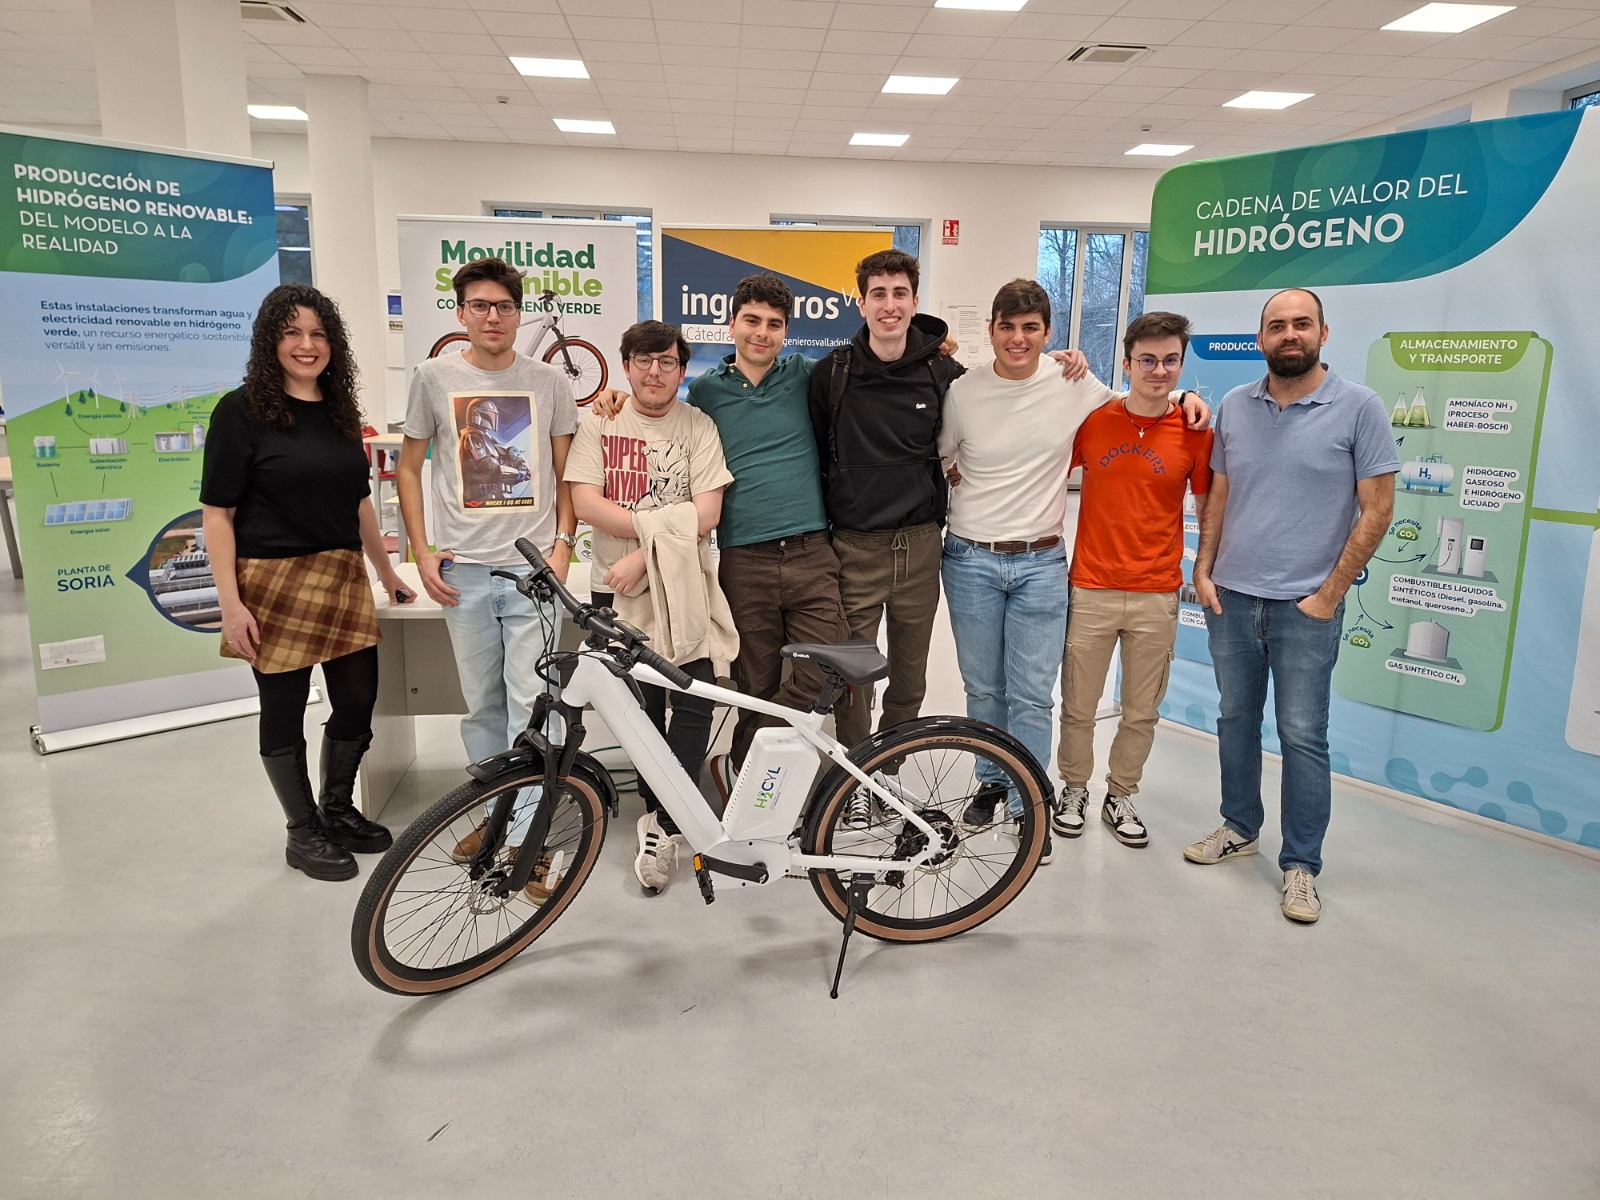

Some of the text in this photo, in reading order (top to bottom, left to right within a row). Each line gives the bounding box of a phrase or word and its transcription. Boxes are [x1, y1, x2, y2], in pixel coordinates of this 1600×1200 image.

[14, 164, 181, 197] PRODUCCIÓN DE
[1196, 173, 1468, 220] CADENA DE VALOR DEL
[17, 187, 253, 225] HIDRÓGENO RENOVABLE:
[20, 211, 192, 240] DEL MODELO A LA
[1193, 212, 1405, 257] HIDRÓGENO
[22, 233, 119, 255] REALIDAD
[441, 239, 596, 269] Movilidad
[435, 267, 603, 297] Snible
[41, 301, 253, 320] Estas instalaciones transforman agua y
[558, 303, 602, 315] VERDE
[42, 314, 113, 326] electricidad
[115, 317, 171, 328] renovable
[189, 319, 241, 331] hidrógeno
[43, 327, 81, 338] verde,
[83, 329, 98, 337] un
[100, 331, 142, 339] recurso
[144, 330, 200, 342] energético
[686, 326, 733, 342] Cátedra
[44, 339, 171, 352] versátil y sin emisiones.
[1208, 342, 1261, 351] PRODUCCI
[1400, 339, 1518, 350] ALMACENAMIENTO
[1409, 354, 1503, 365] Y TRANSPORTE
[1449, 399, 1494, 409] AMONÍACO
[1447, 410, 1489, 419] (PROCESO
[1446, 420, 1509, 431] HABER-BOSCH)
[601, 434, 648, 473] SUPER
[1098, 443, 1167, 475] DOCKERS
[1466, 468, 1517, 479] HIDRÓGENO
[606, 470, 648, 502] AIYAN
[1465, 478, 1505, 488] GASEOSO
[1471, 489, 1522, 501] HIDRÓGENO
[1463, 499, 1500, 509] LICUADO
[1389, 518, 1422, 536] Se necesita
[57, 564, 112, 577] PLANTA DE
[57, 574, 116, 593] SORIA
[1393, 576, 1494, 597] COMBUSTIBLES LÍQUIDOS
[1392, 585, 1504, 610] SINTÉTICOS (Diesel, gasolina,
[1342, 626, 1375, 642] Se necesita
[1388, 661, 1403, 670] GAS
[1404, 664, 1444, 679] SINTÉTICO
